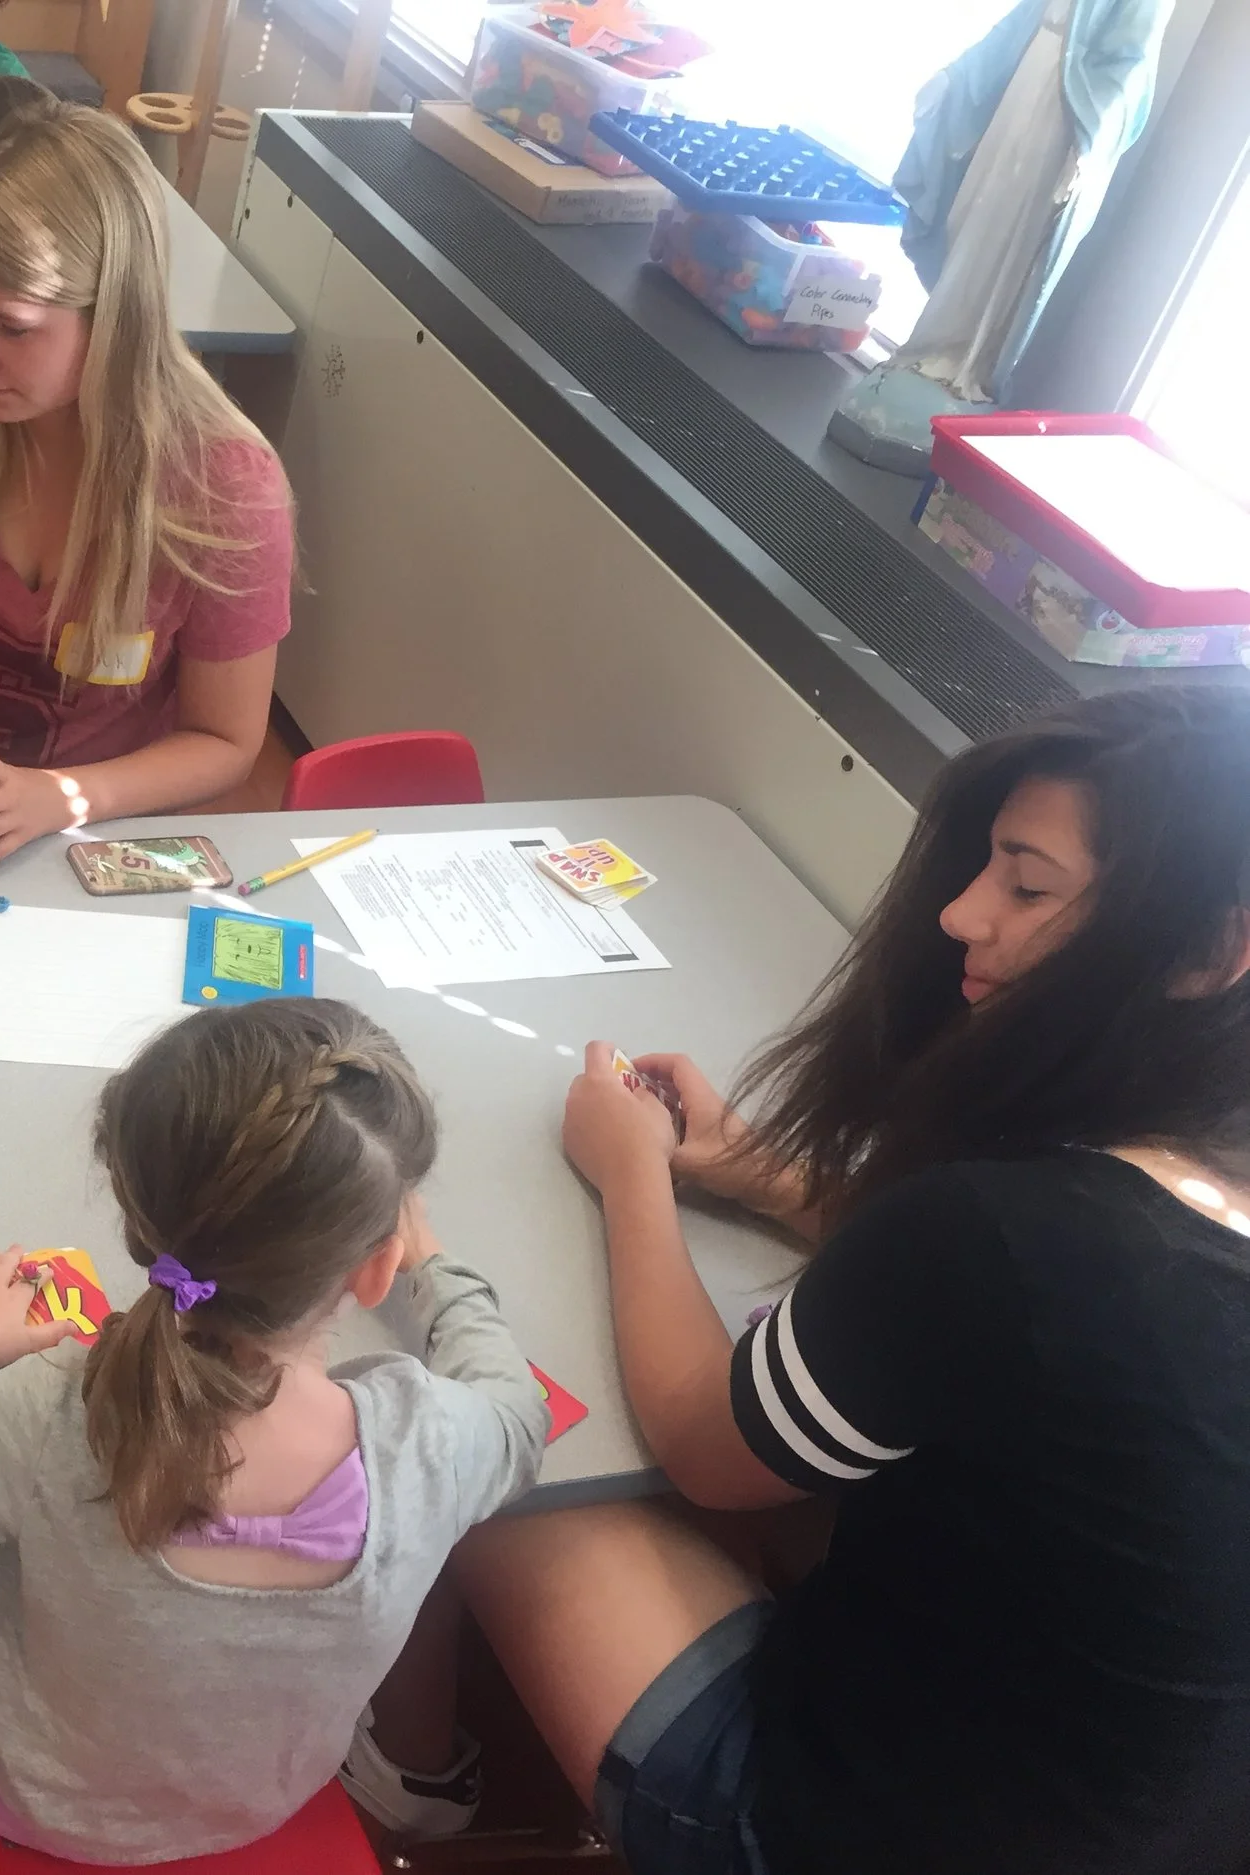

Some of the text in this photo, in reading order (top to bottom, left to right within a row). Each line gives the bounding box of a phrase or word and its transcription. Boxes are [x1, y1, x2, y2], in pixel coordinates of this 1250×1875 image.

[799, 286, 827, 299] Color
[548, 853, 601, 882] SNAP
[38, 1265, 98, 1335] k
